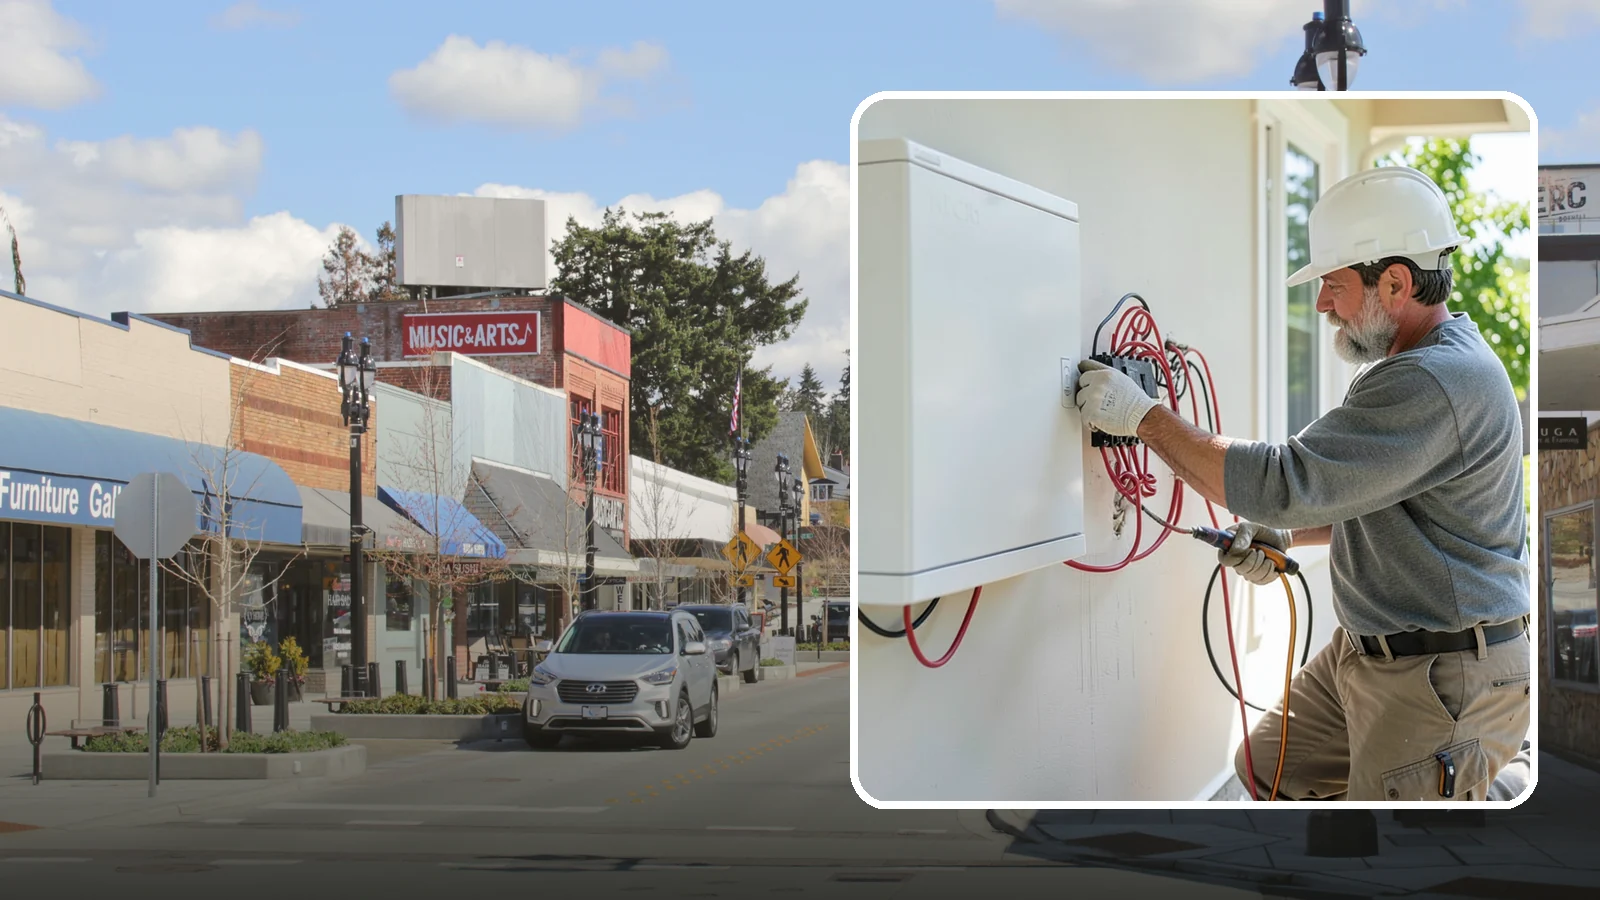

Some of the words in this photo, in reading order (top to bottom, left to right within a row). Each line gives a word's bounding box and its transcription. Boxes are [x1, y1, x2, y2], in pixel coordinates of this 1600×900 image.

[409, 323, 519, 349] MUSIC&ARTS
[1540, 427, 1577, 437] UGA
[0, 471, 79, 515] Furniture
